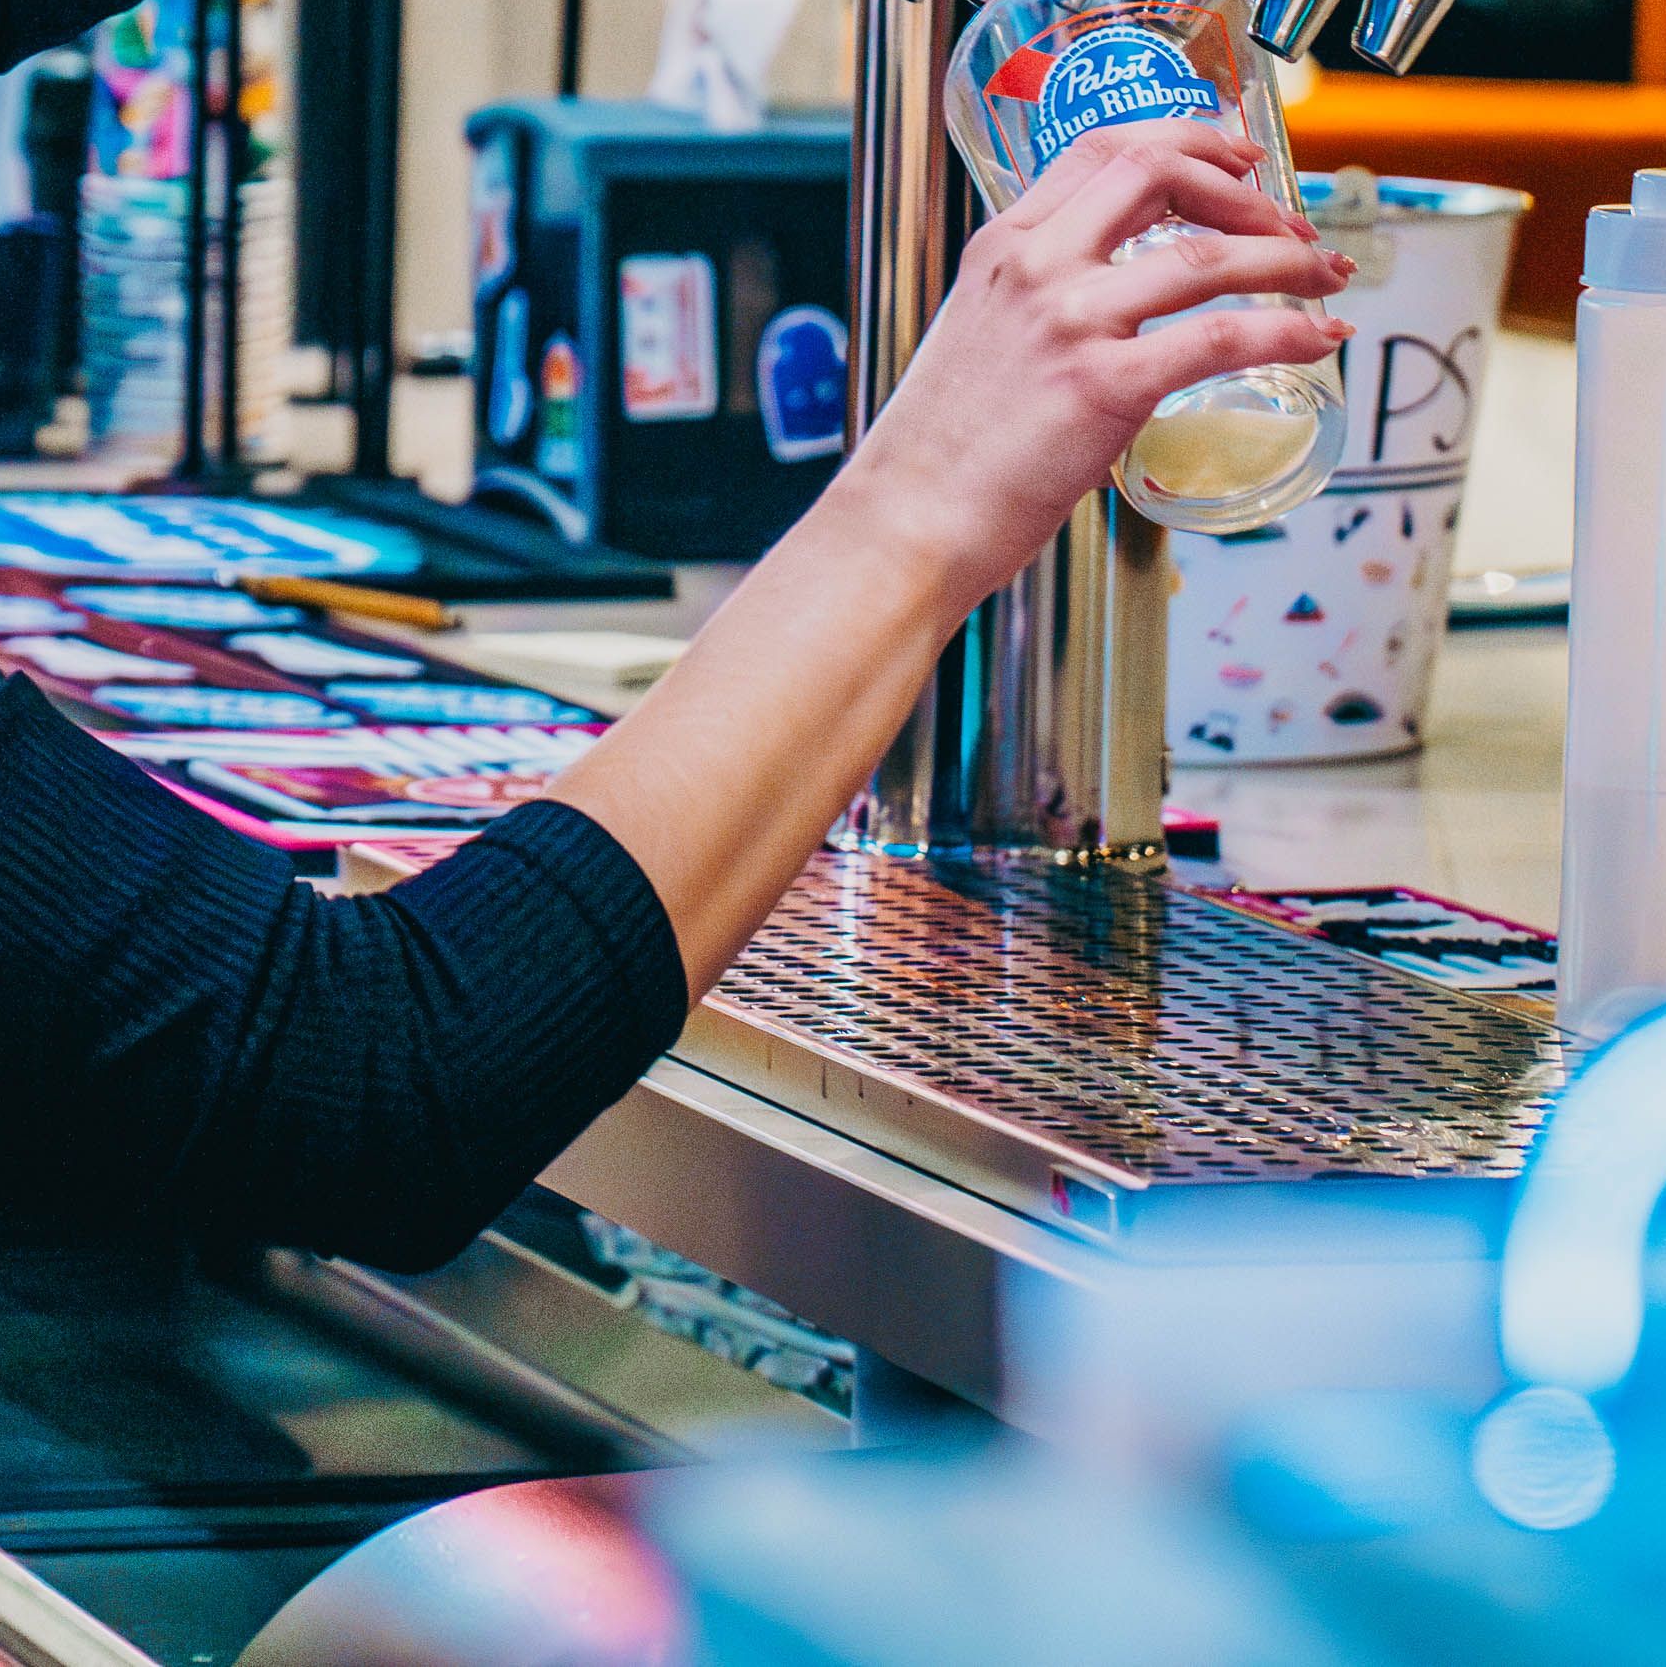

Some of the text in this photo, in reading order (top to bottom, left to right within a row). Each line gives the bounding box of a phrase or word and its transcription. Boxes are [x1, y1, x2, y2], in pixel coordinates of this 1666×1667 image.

[1064, 49, 1158, 105] Pabst
[1034, 79, 1214, 161] Blue Ribbon
